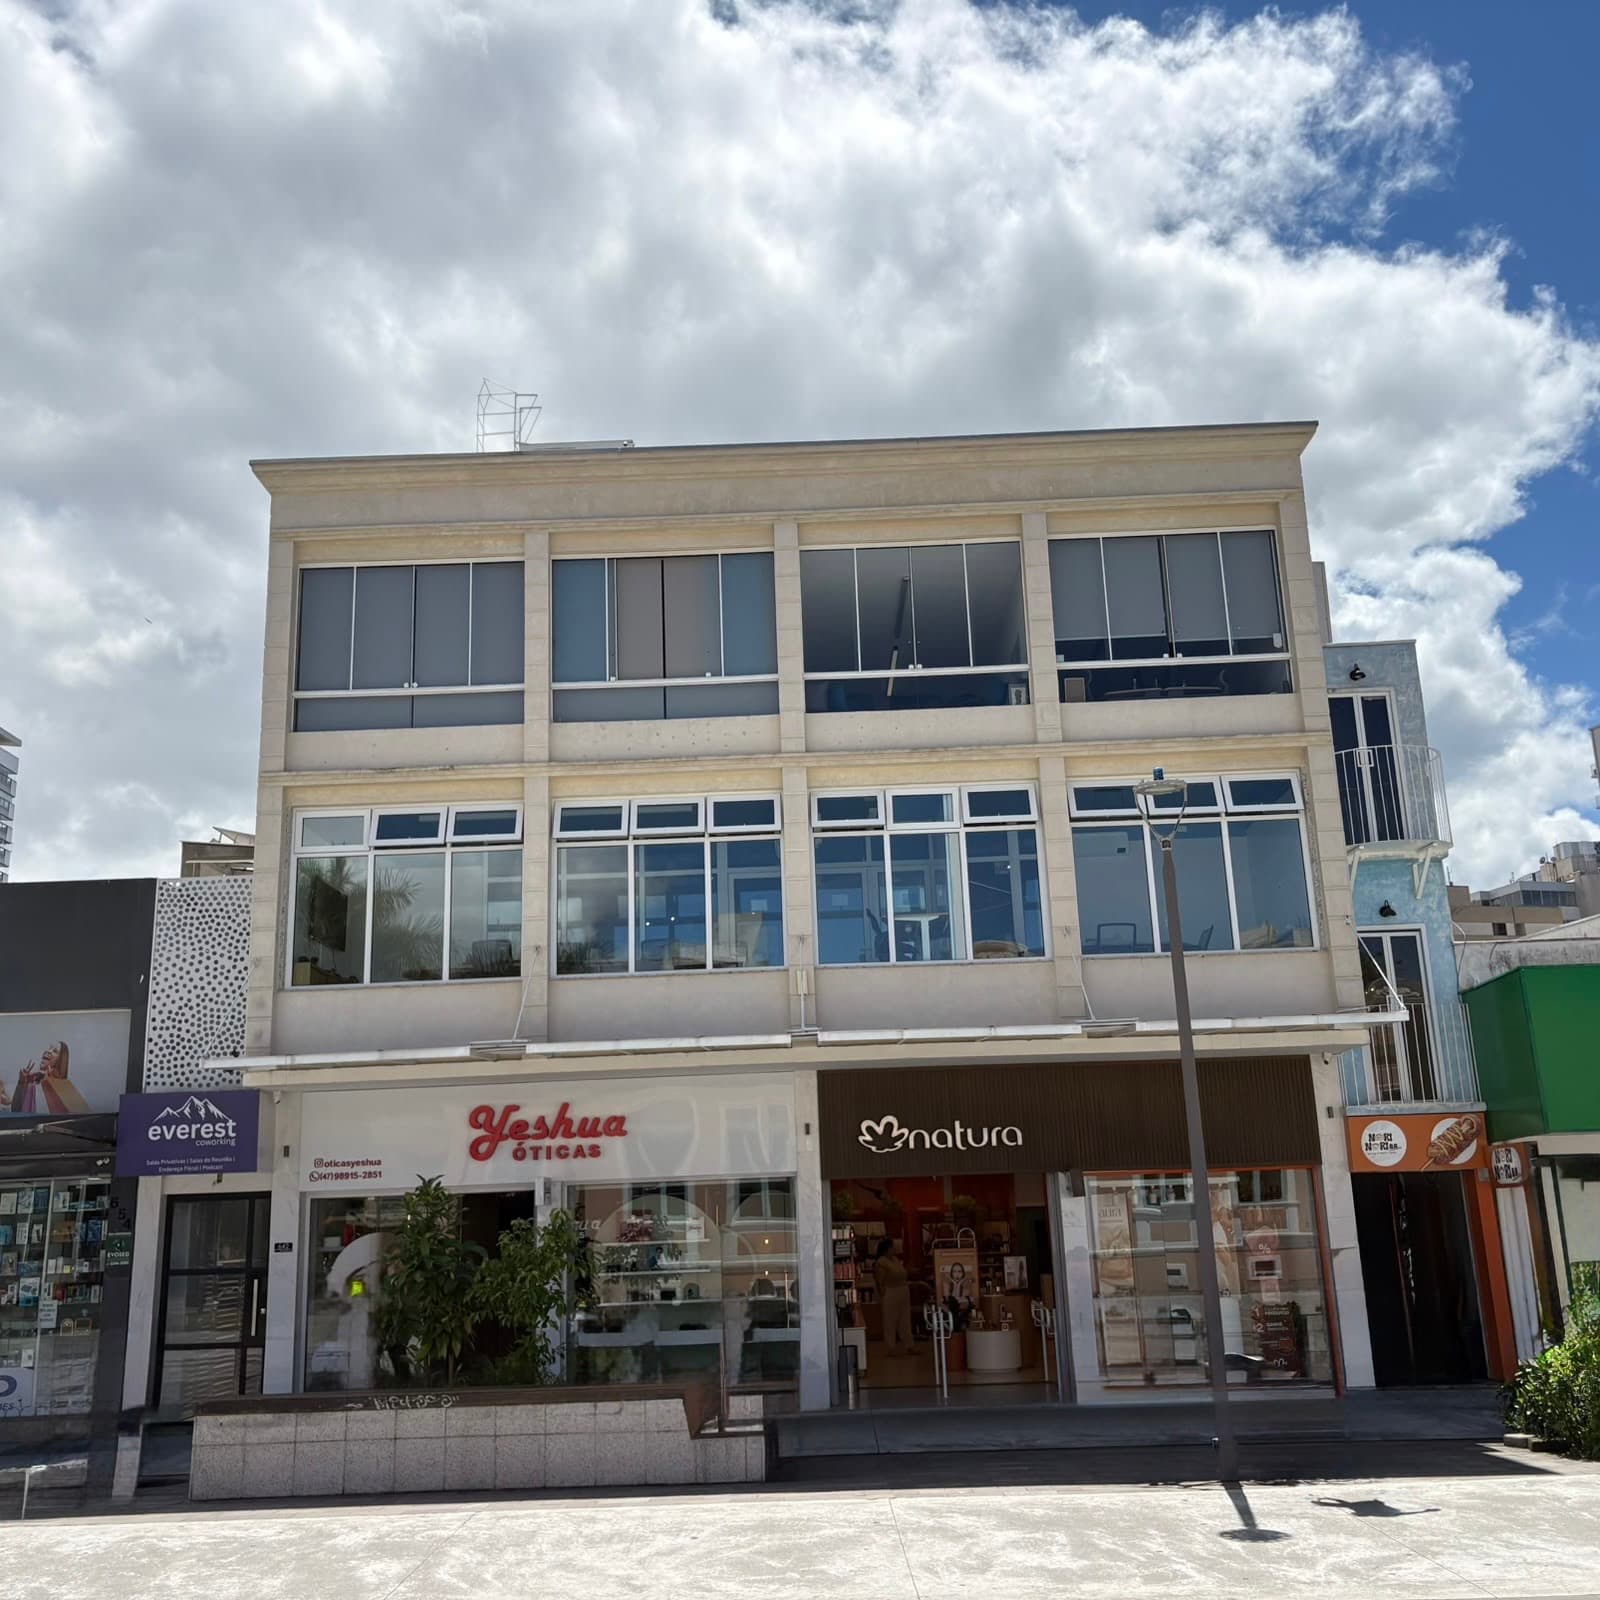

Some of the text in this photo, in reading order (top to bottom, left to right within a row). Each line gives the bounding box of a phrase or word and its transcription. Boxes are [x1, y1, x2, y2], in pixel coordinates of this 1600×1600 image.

[148, 1119, 237, 1141] everest
[468, 1102, 627, 1162] Yeshua
[908, 1120, 1023, 1150] natura
[195, 1137, 236, 1147] coworking
[512, 1142, 602, 1162] ÓTICAS
[324, 1158, 382, 1169] oticasyeshua
